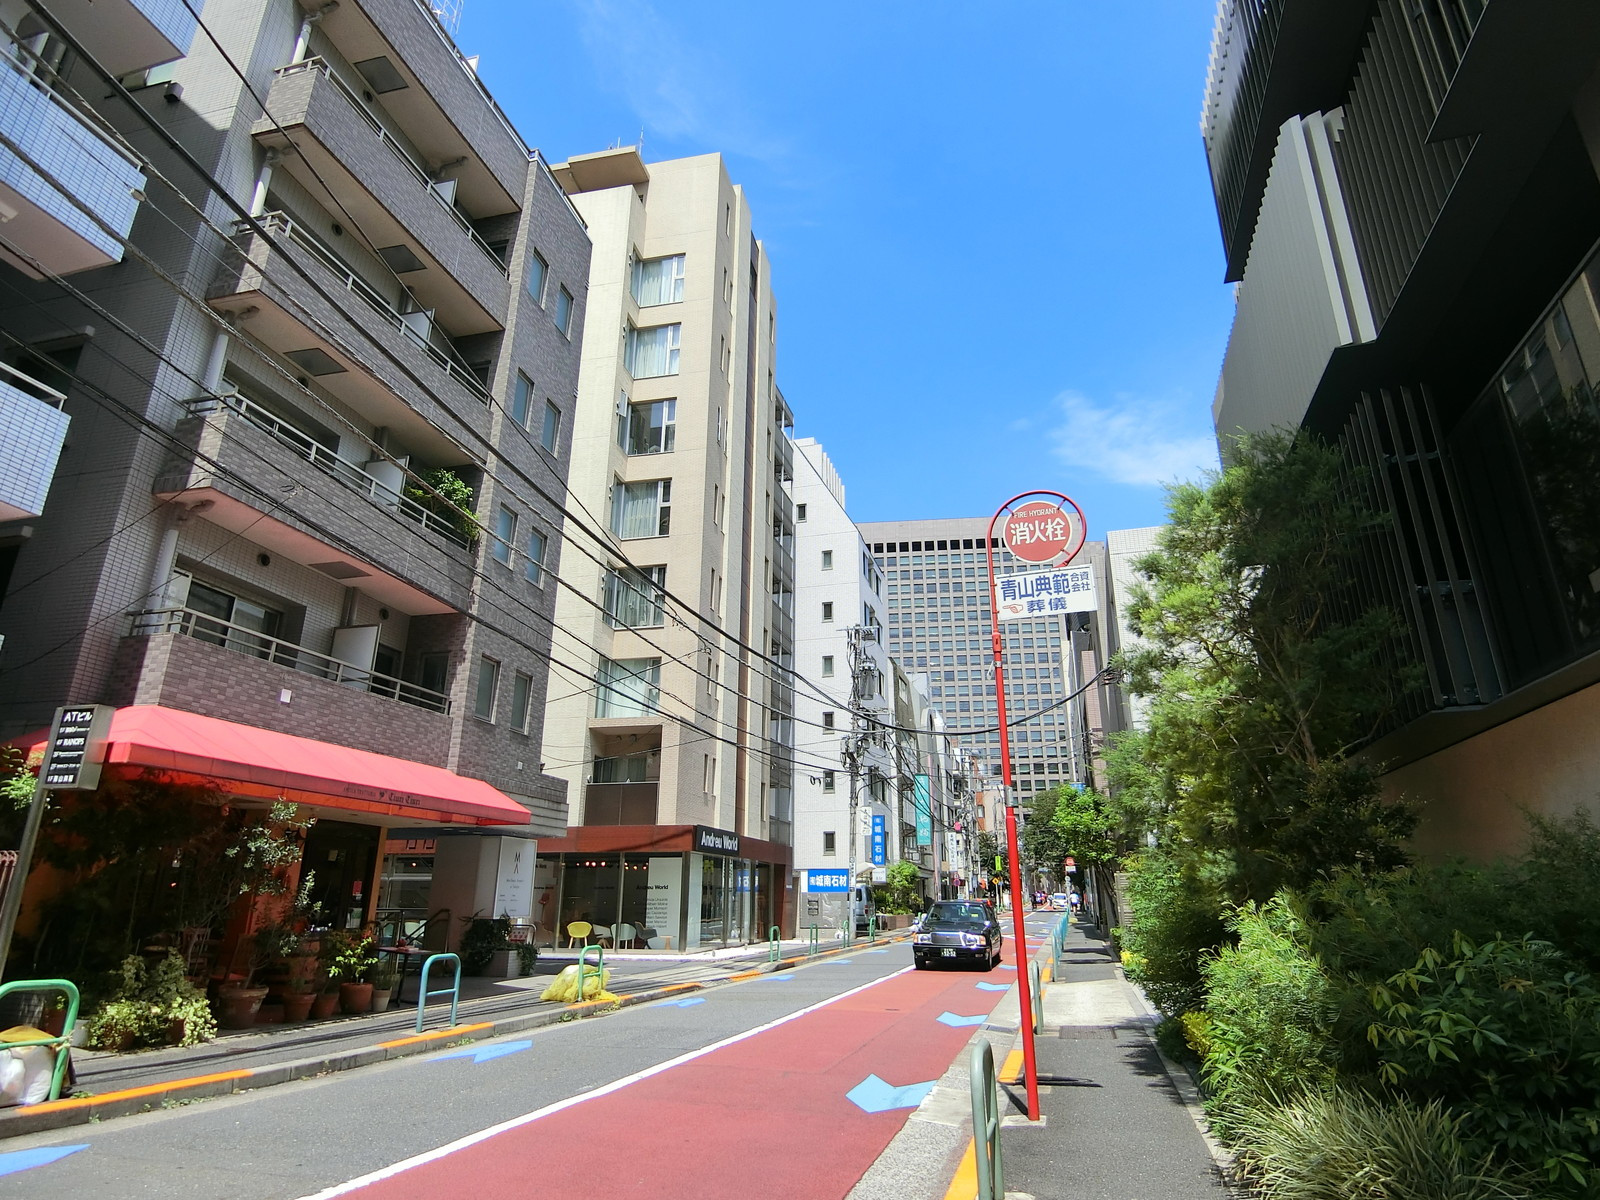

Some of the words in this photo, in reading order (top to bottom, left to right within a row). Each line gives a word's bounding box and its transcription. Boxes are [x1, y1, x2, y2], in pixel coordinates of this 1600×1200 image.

[1030, 508, 1058, 517] HYDRANT
[1010, 517, 1066, 546] 消火栓
[1000, 573, 1070, 602] 青山典範
[1026, 596, 1067, 613] 葬儀
[64, 712, 92, 722] ATビル
[701, 831, 723, 849] Andreu
[723, 834, 738, 851] World
